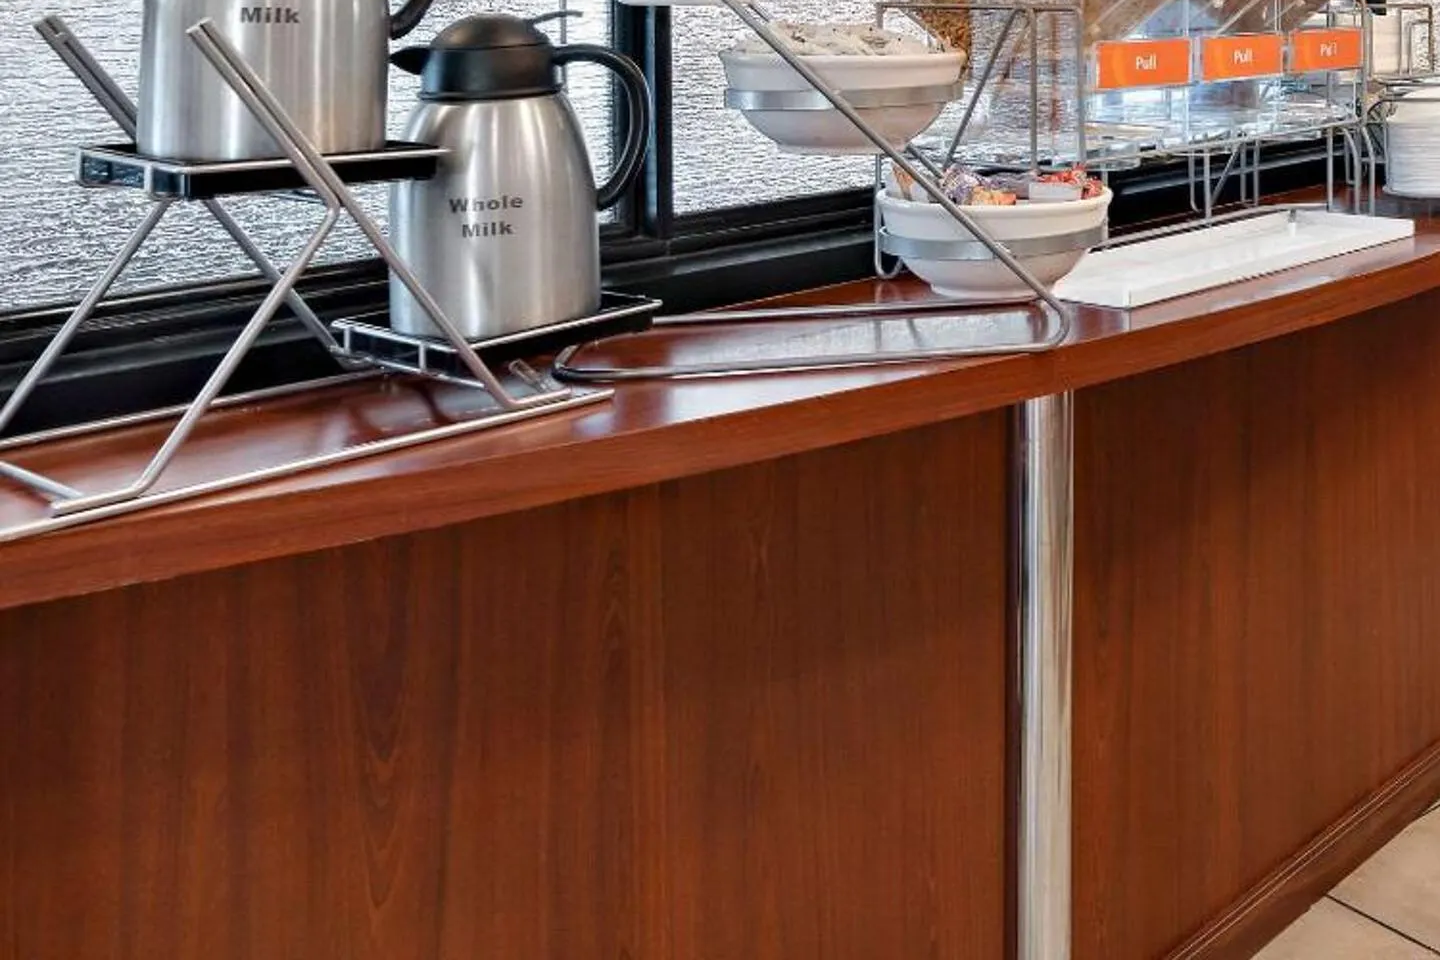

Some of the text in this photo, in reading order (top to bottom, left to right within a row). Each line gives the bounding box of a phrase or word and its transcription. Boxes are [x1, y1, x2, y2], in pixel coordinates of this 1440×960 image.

[240, 6, 300, 23] Milk
[1135, 54, 1157, 71] Pull
[1233, 47, 1253, 65] Pull
[449, 195, 523, 214] Whole
[462, 221, 513, 238] Milk
